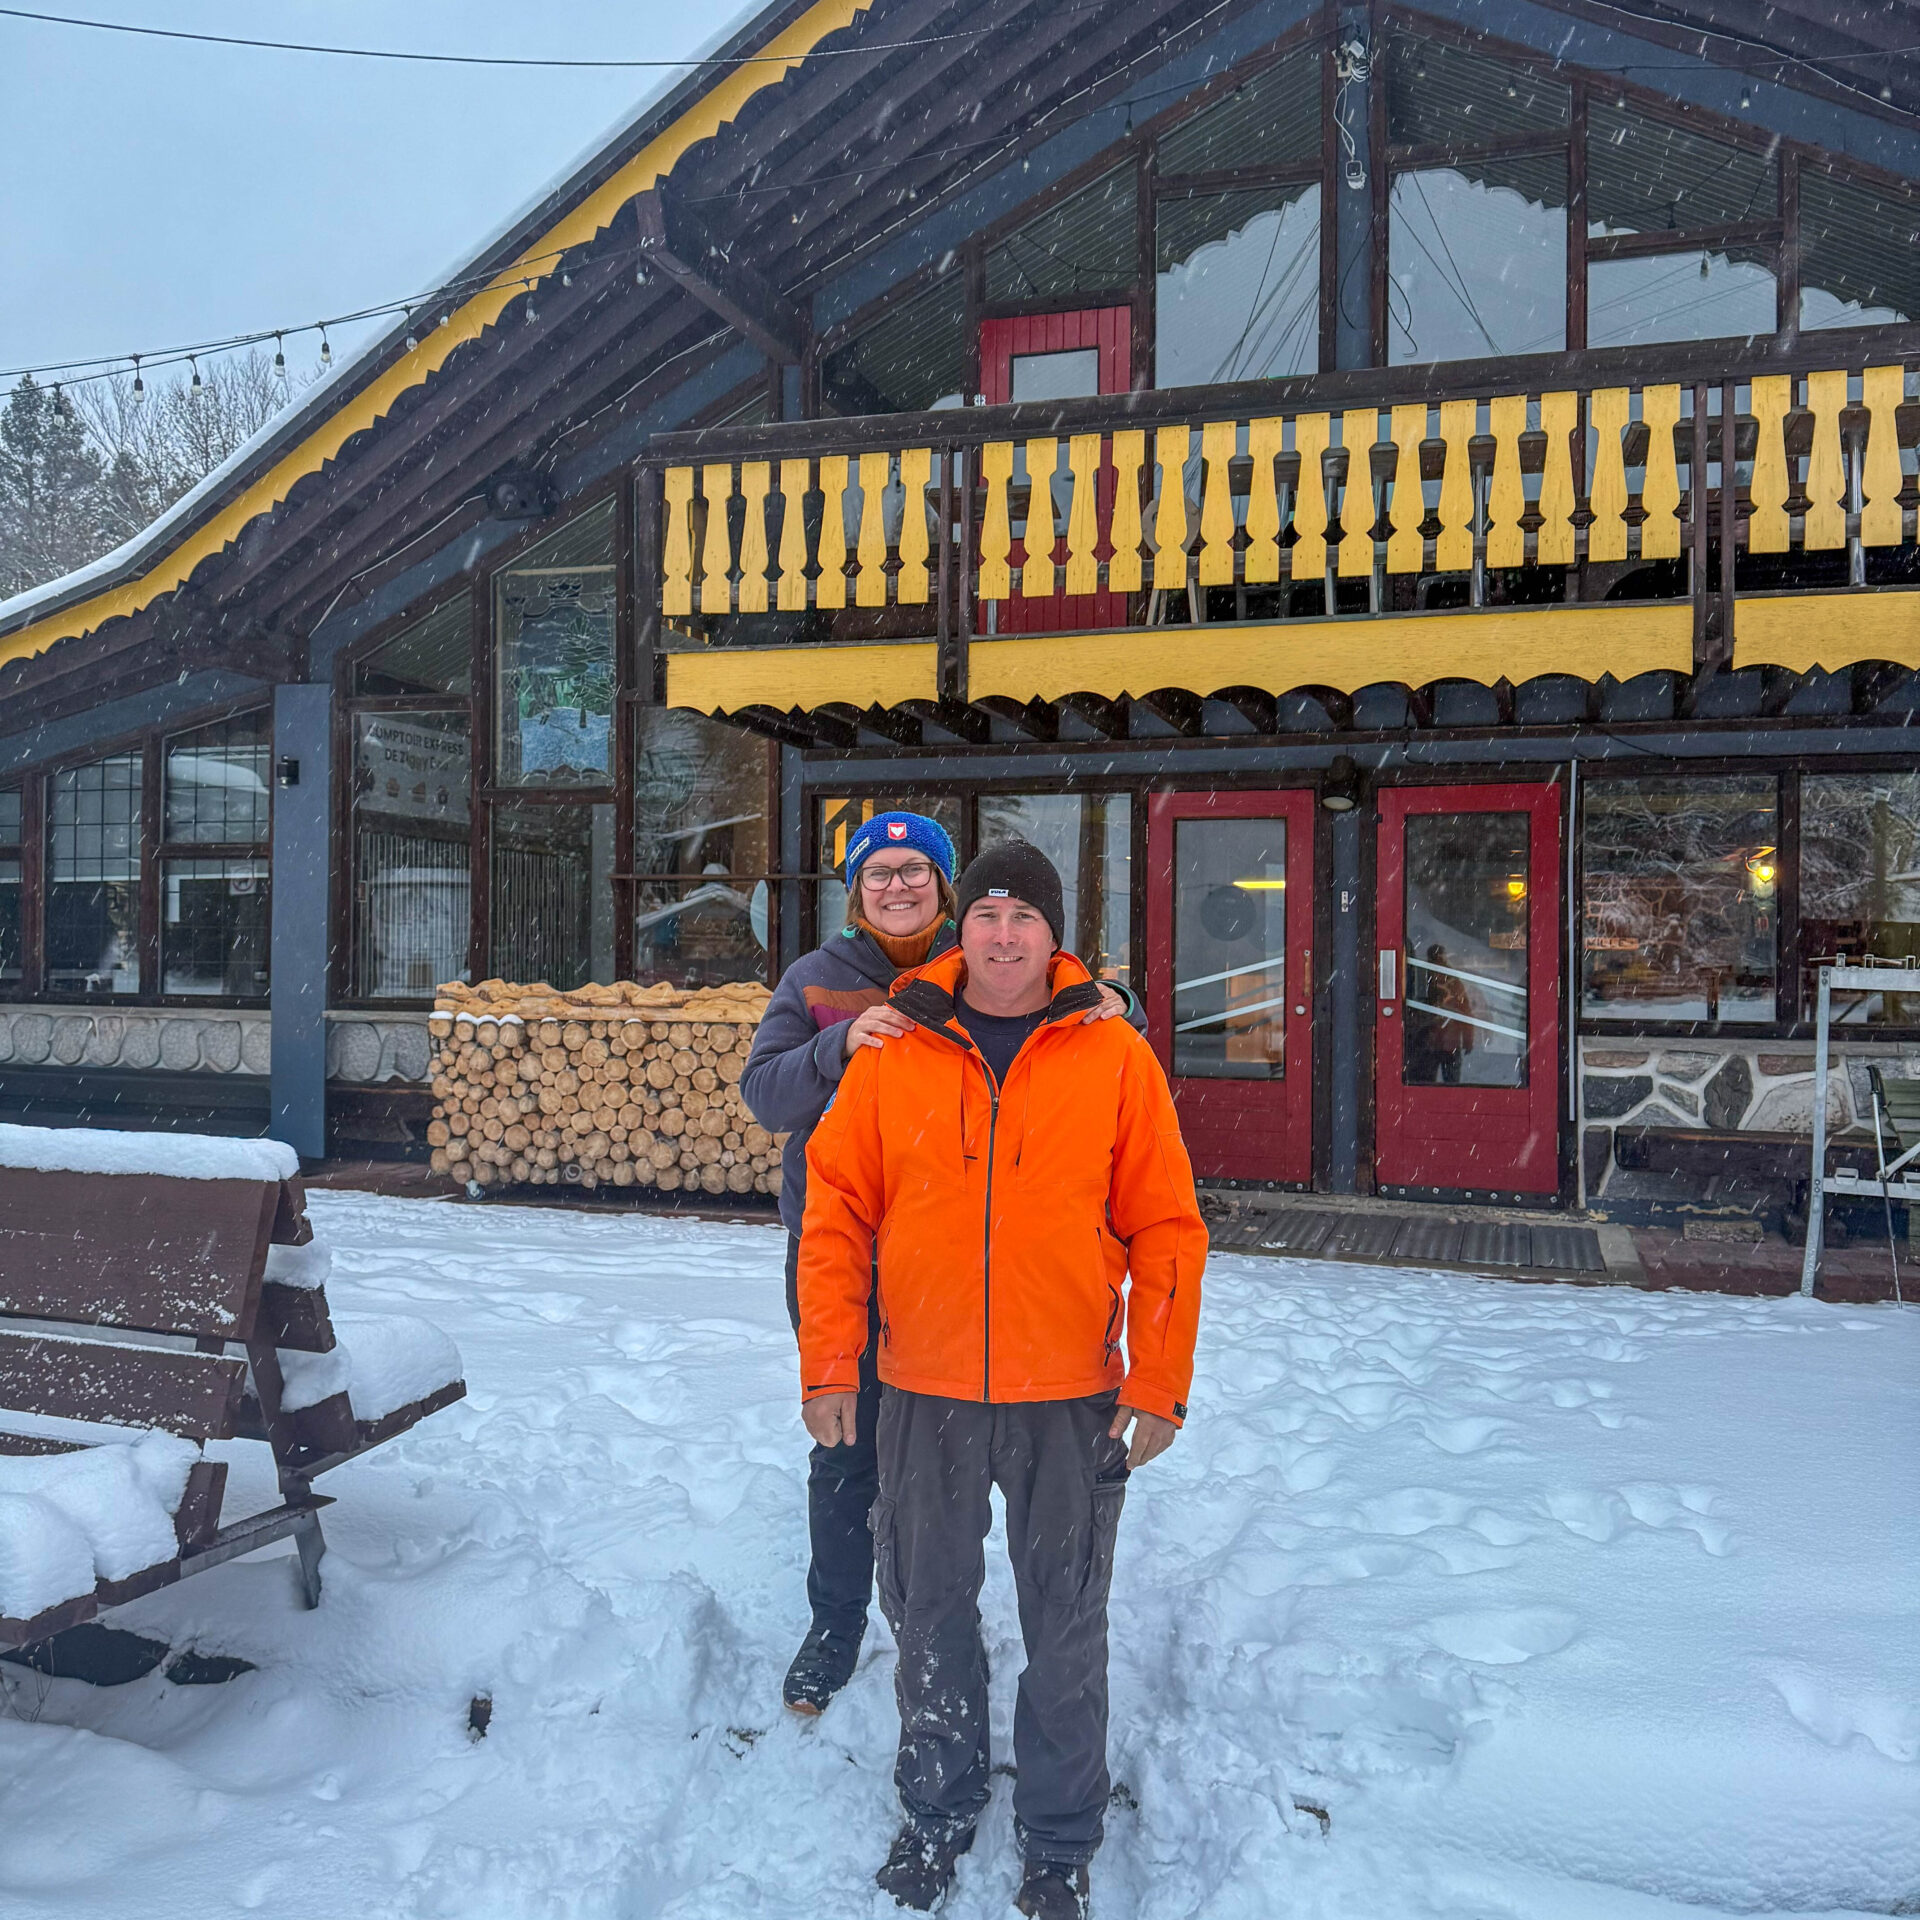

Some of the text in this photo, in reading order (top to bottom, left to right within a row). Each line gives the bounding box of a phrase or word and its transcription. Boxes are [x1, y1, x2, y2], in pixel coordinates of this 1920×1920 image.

[368, 724, 464, 756] COMPTOIR EXPRESS
[384, 747, 399, 761] DE
